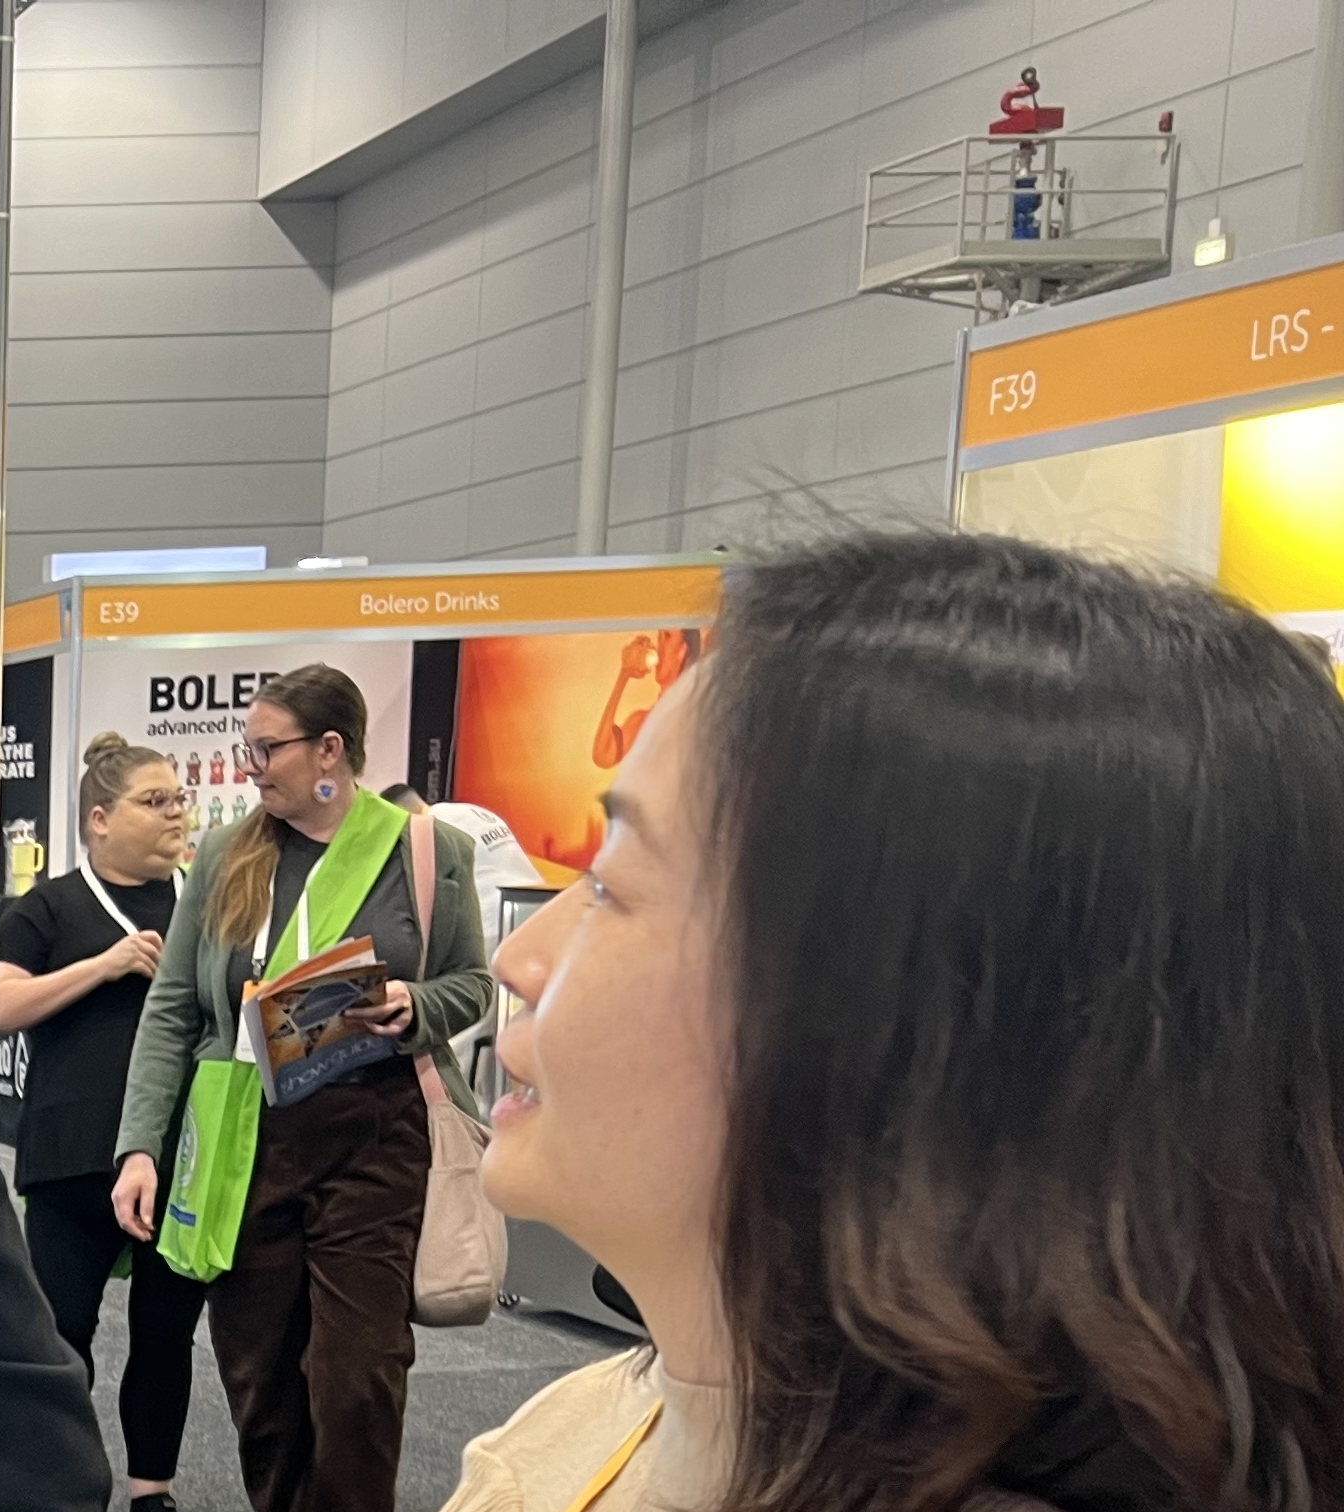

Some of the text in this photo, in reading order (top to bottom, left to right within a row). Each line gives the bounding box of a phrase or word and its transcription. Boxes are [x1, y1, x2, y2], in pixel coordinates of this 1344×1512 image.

[1250, 308, 1311, 361] LRS
[989, 370, 1037, 415] F39
[99, 602, 139, 624] E39
[360, 591, 499, 615] Bolero Drinks
[146, 716, 227, 737] advanced
